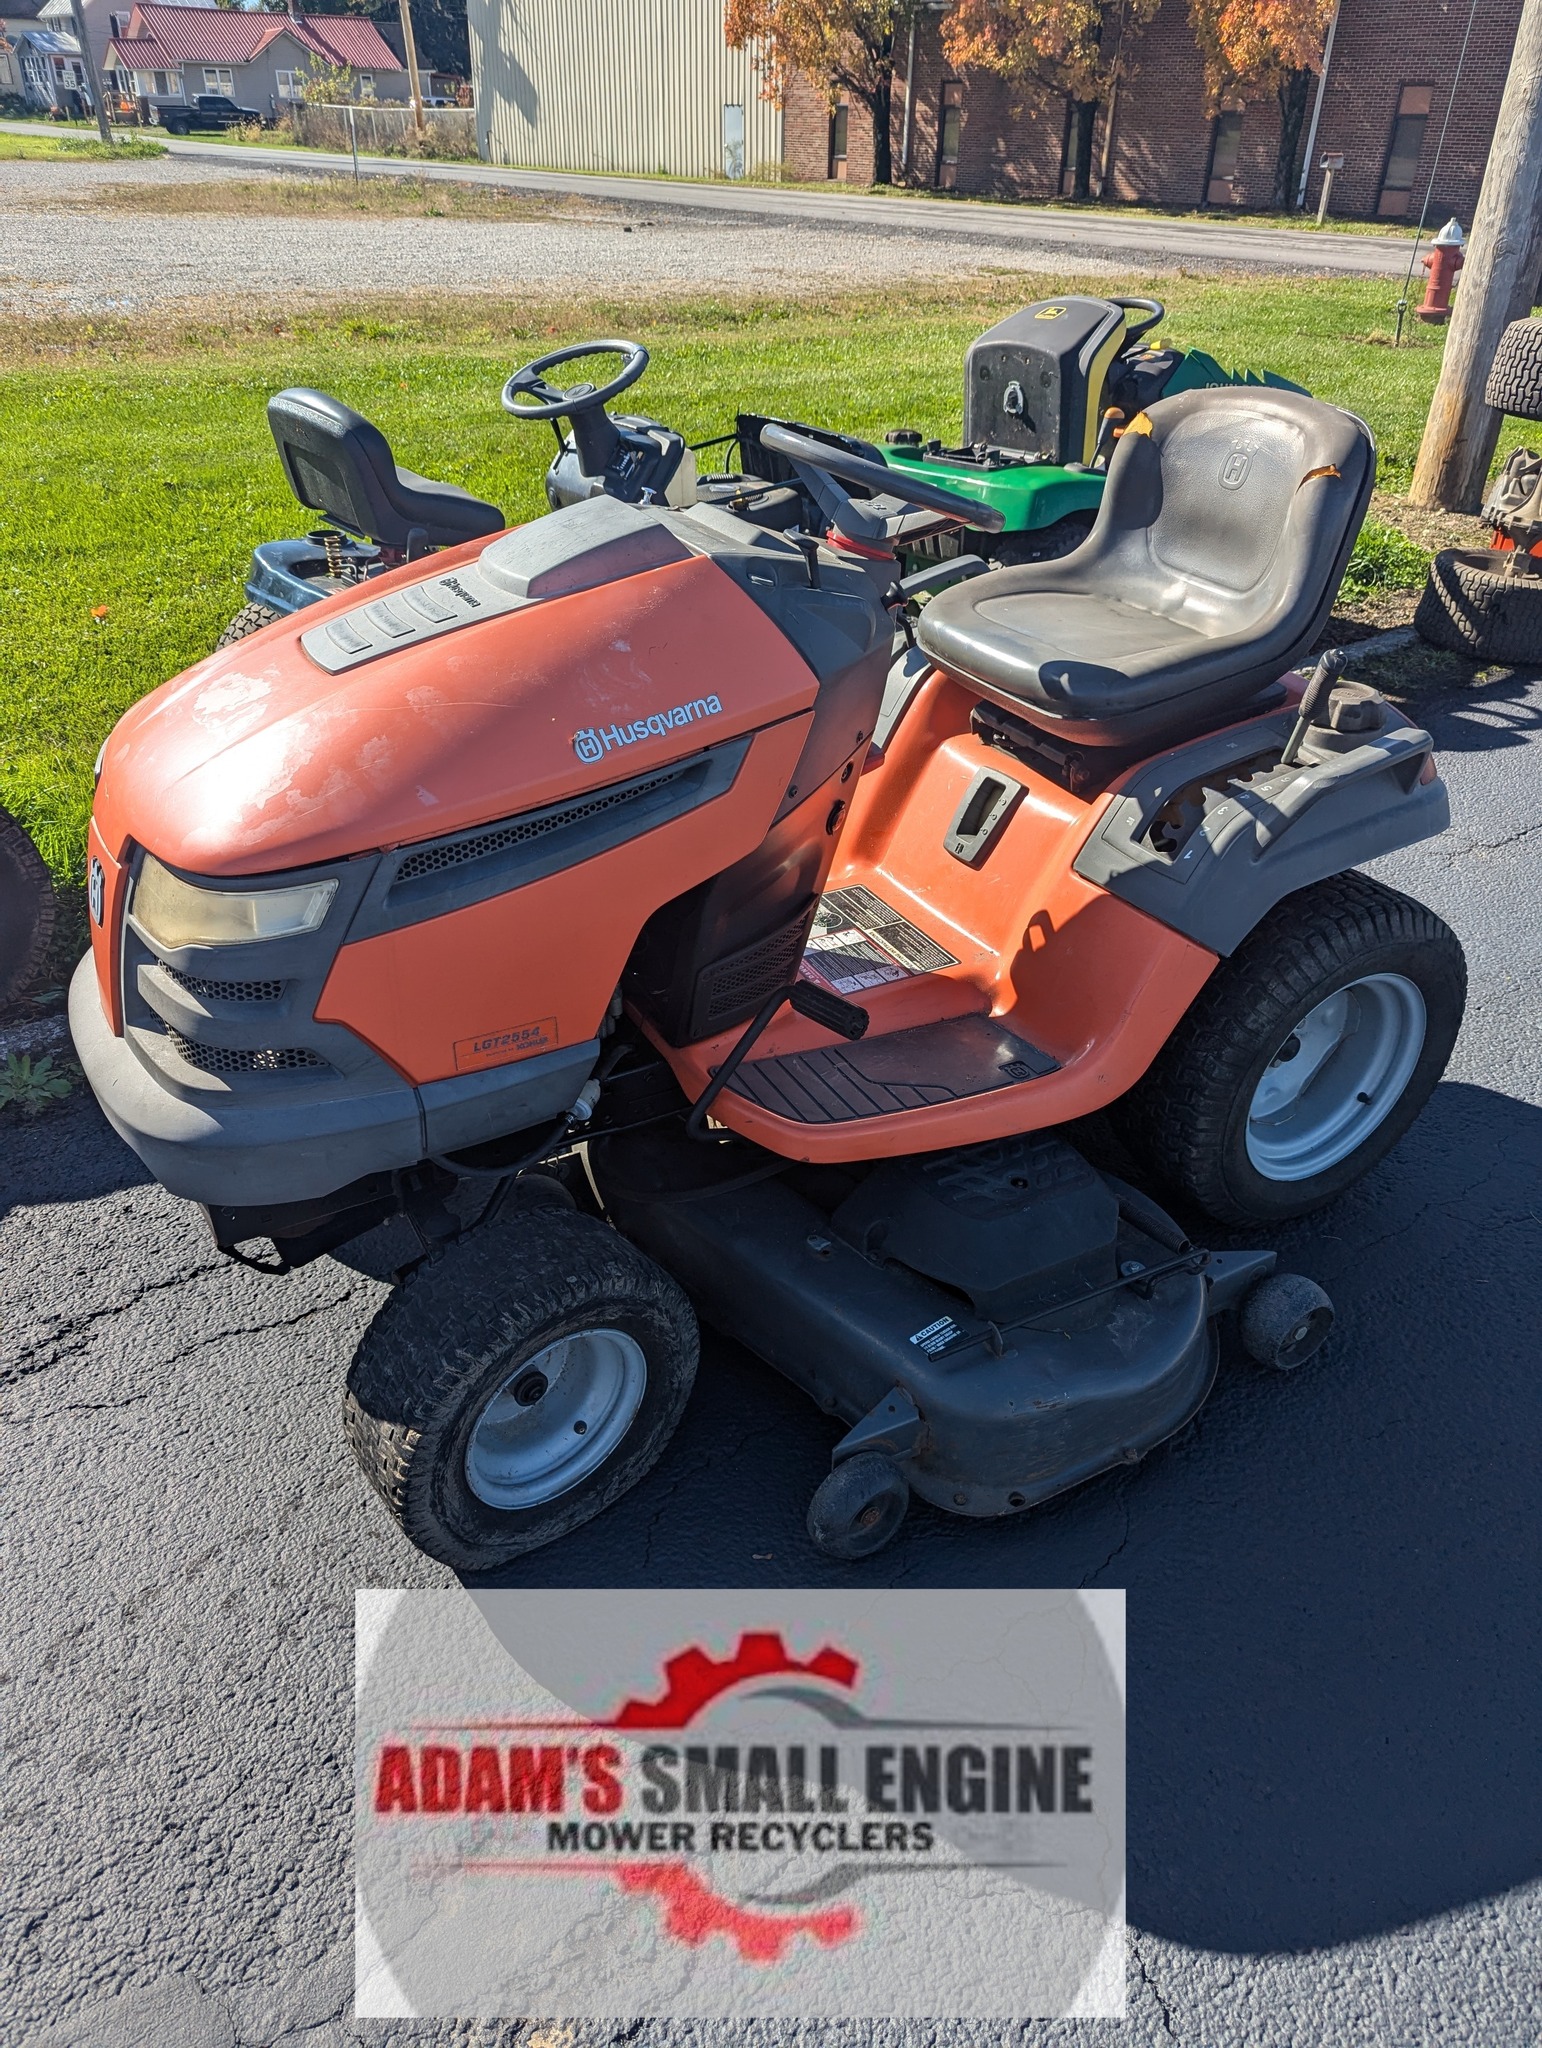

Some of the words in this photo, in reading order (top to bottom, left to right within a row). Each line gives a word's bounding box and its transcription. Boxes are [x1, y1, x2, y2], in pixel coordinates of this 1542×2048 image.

[65, 80, 76, 88] 35
[598, 694, 723, 752] Husqvarna
[1217, 806, 1229, 815] 3
[473, 1026, 540, 1053] LGT2554
[920, 1317, 949, 1337] CAUTION
